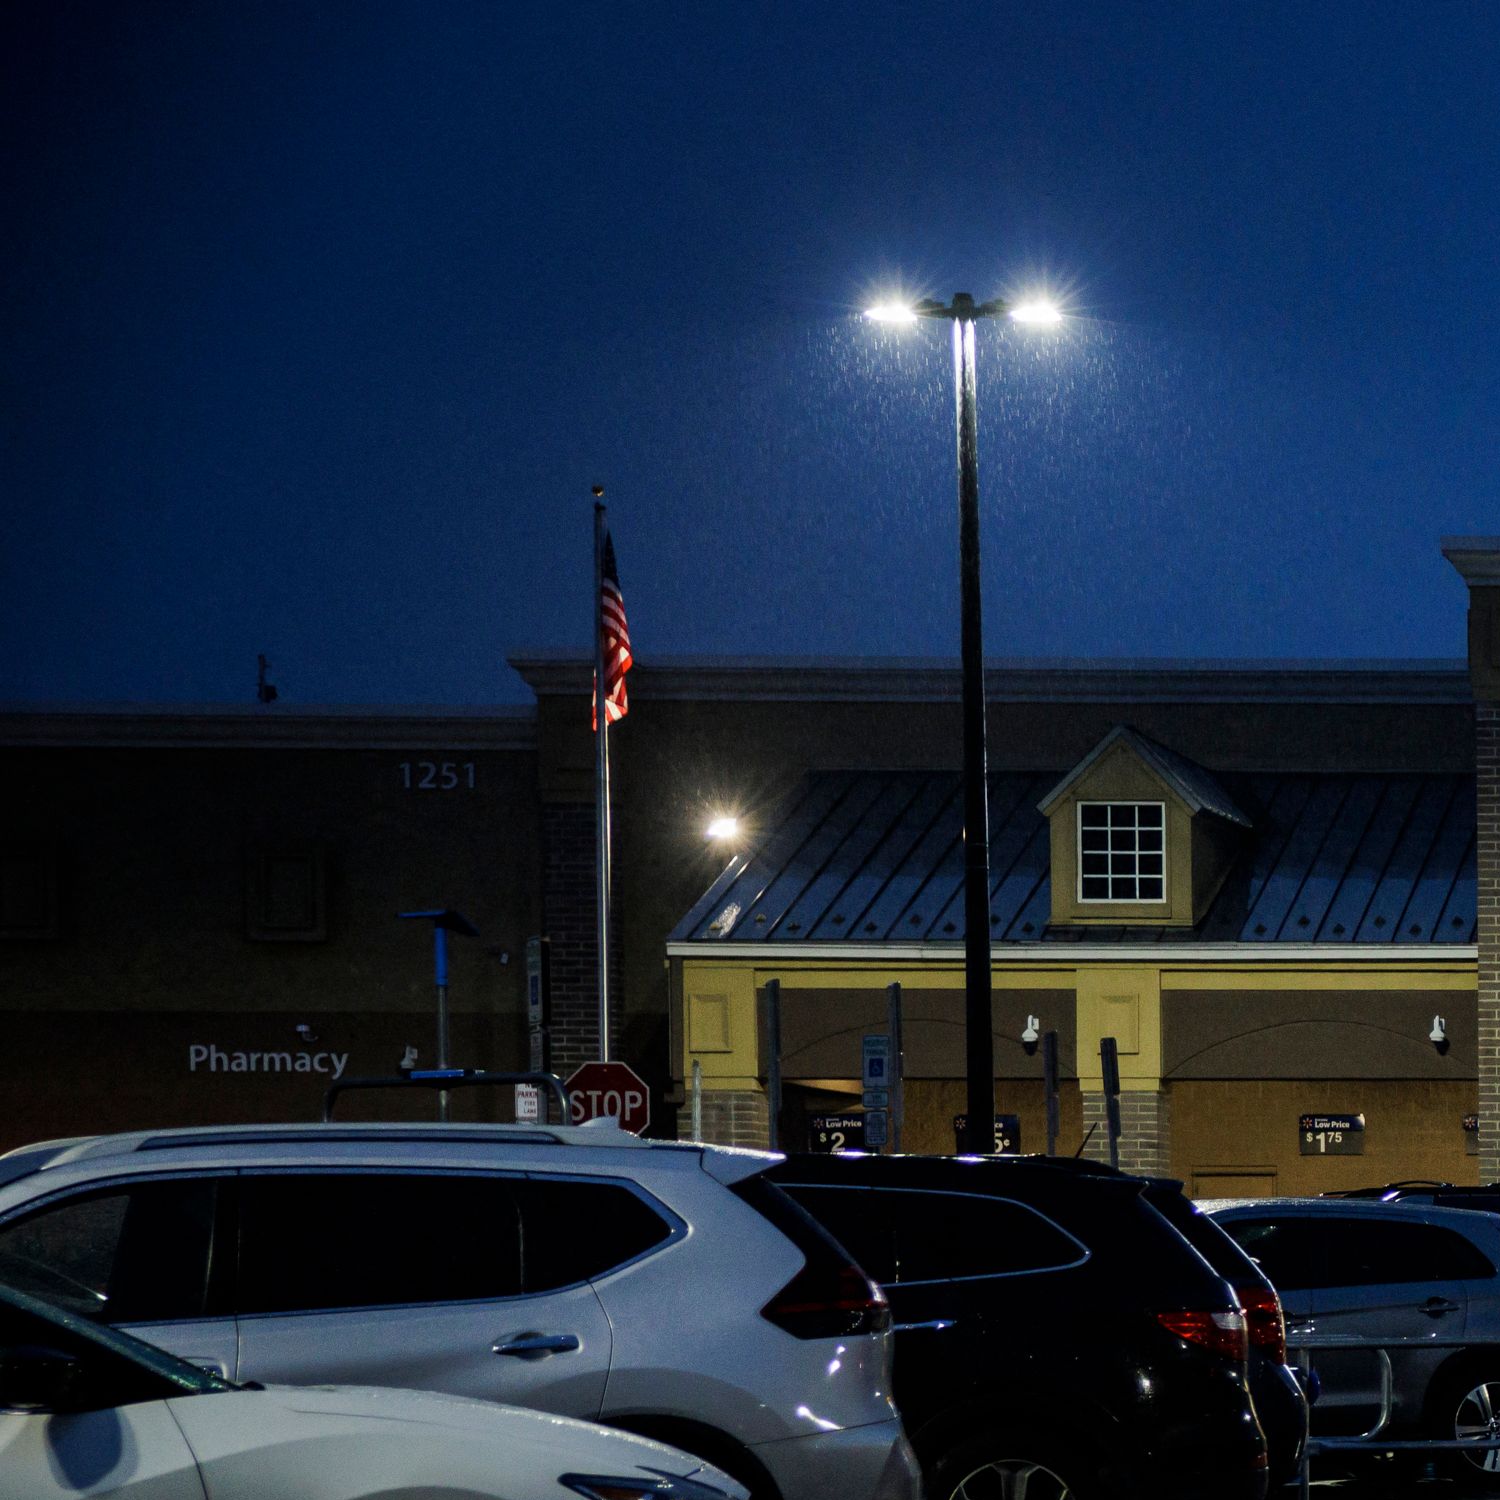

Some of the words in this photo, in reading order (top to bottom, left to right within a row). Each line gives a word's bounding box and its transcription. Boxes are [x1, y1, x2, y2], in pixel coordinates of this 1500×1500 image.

[399, 761, 477, 789] 1251
[189, 1044, 349, 1080] Pharmacy
[569, 1089, 644, 1122] STOP
[825, 1119, 842, 1128] Low
[843, 1120, 862, 1128] Price
